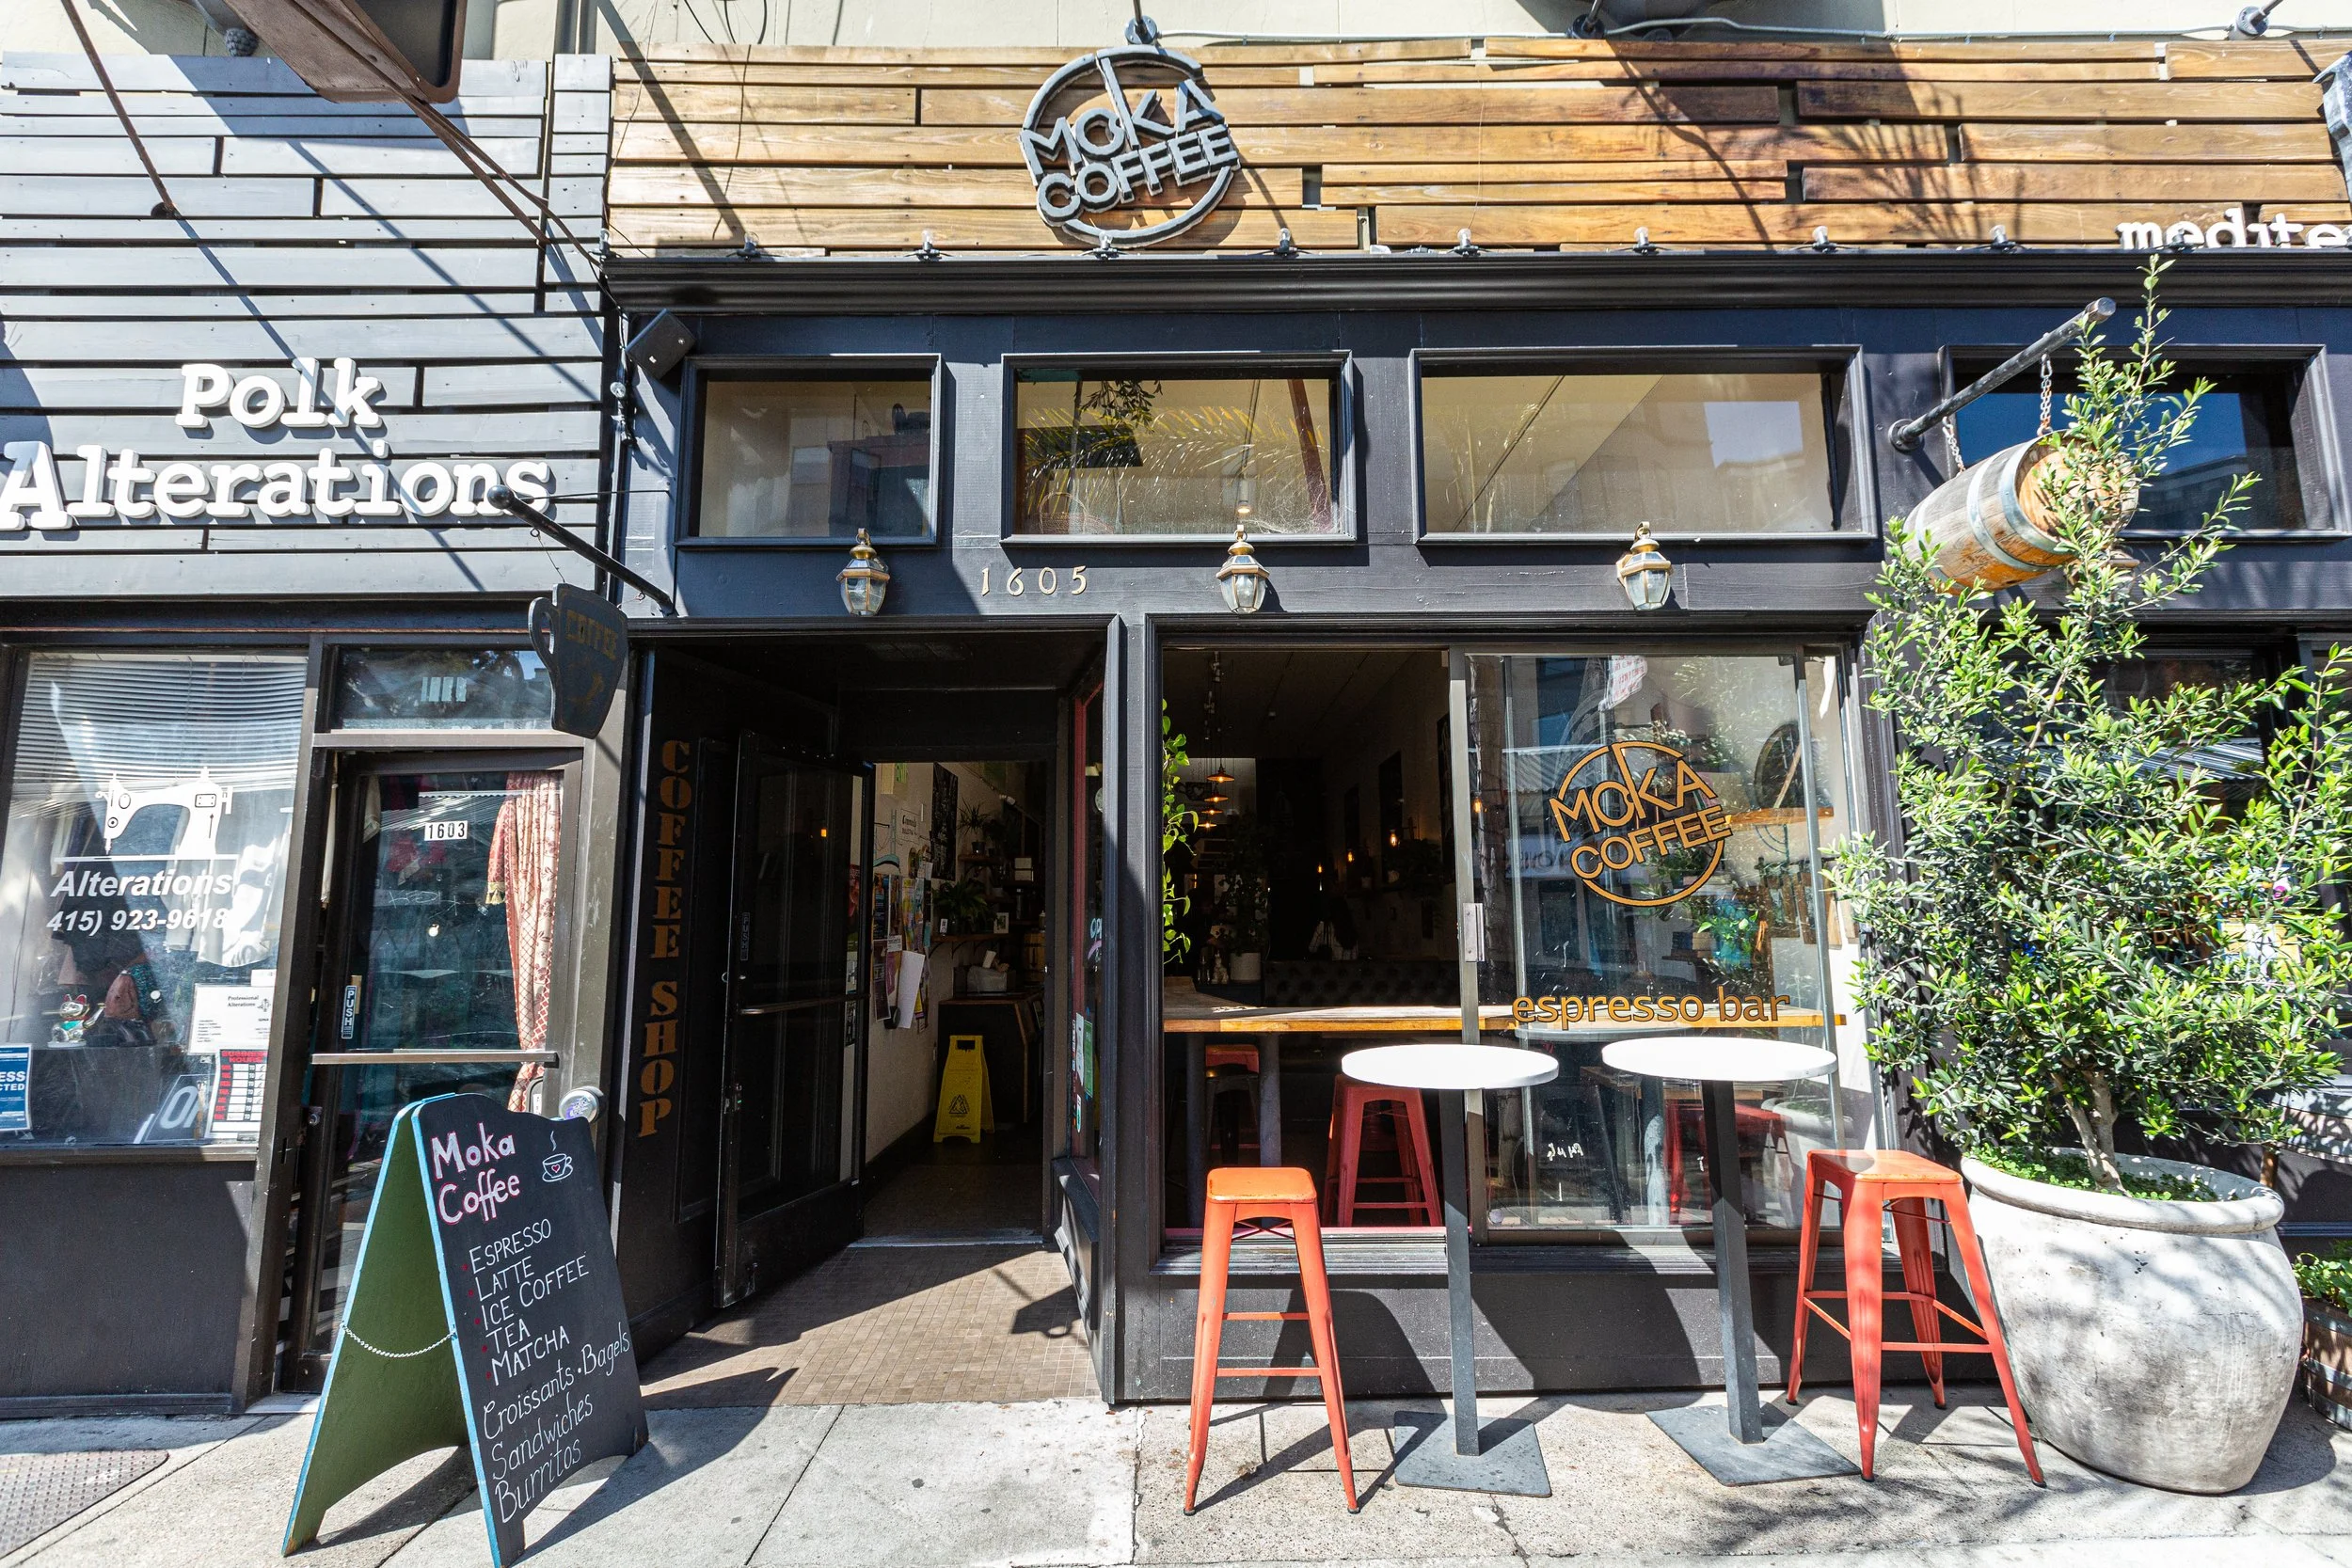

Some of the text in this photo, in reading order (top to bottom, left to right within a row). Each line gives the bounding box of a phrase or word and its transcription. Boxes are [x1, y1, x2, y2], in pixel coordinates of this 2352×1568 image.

[1019, 56, 1225, 186] MOKA
[1036, 123, 1241, 227] COFFEE
[174, 356, 383, 429] Polk
[0, 440, 557, 531] Alterations
[981, 565, 1088, 596] 1605
[565, 610, 618, 660] COFFEE
[1549, 742, 1719, 843] MOKA
[429, 822, 465, 839] 1603
[1570, 804, 1734, 879] COFFEE
[50, 868, 232, 897] Alterations
[111, 907, 228, 931] 923-9618
[637, 739, 691, 1138] COFFEE SHOP
[344, 990, 355, 1026] PUSH
[1511, 985, 1791, 1030] espresso bar
[431, 1122, 516, 1180] Moka
[438, 1168, 520, 1225] Coffee
[469, 1218, 551, 1275] ESPRESSO
[475, 1256, 535, 1302] LATTE
[481, 1254, 590, 1330] ICE COFFEE
[485, 1318, 532, 1354] TEA
[491, 1325, 570, 1386] MATCHA
[483, 1359, 575, 1440] Croissants
[491, 1392, 594, 1480] Sandwiches
[495, 1438, 581, 1524] Burritos
